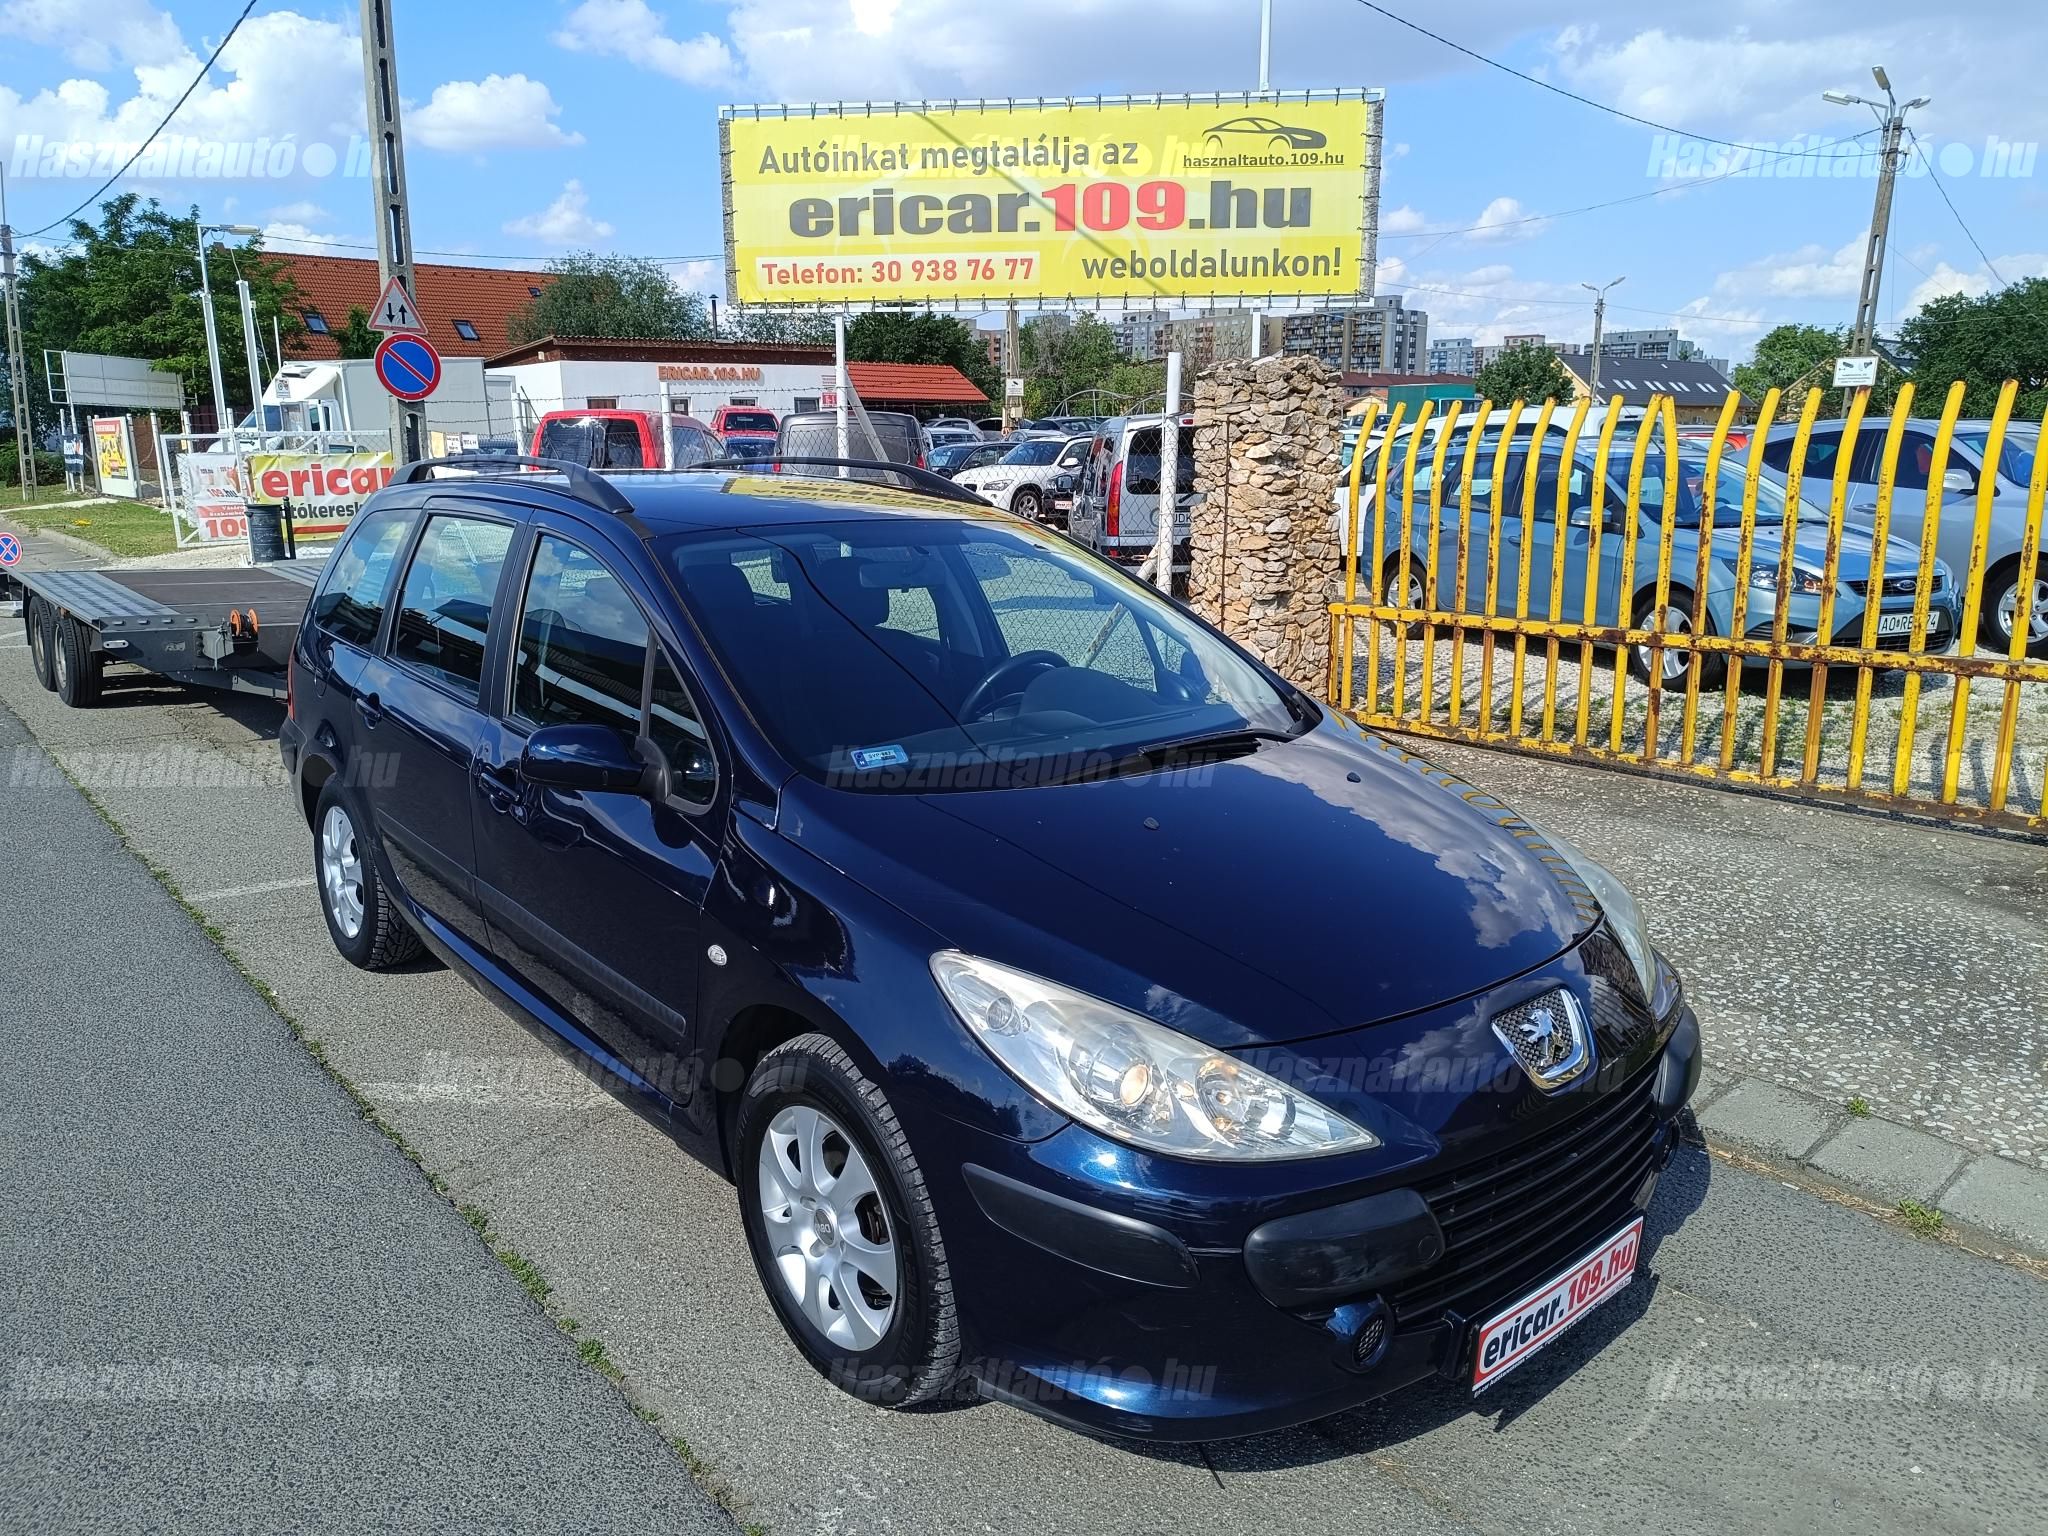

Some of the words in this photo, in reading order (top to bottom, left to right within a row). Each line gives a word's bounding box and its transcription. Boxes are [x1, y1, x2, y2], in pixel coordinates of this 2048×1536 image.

[758, 139, 910, 176] Autóinkat
[920, 130, 1090, 172] megtalálja
[1103, 140, 1139, 165] az
[1182, 152, 1344, 168] hasznaltauto.109.hu
[788, 179, 1312, 239] ericar.109.hu
[762, 262, 864, 286] Telefon:
[871, 261, 902, 284] 30
[910, 260, 958, 283] 938
[966, 259, 996, 282] 76
[1004, 257, 1034, 281] 77
[1081, 246, 1342, 281] weboldalunkon!
[658, 366, 760, 381] ERICAR.109.HU
[1483, 1240, 1634, 1369] ericar.109.hu
